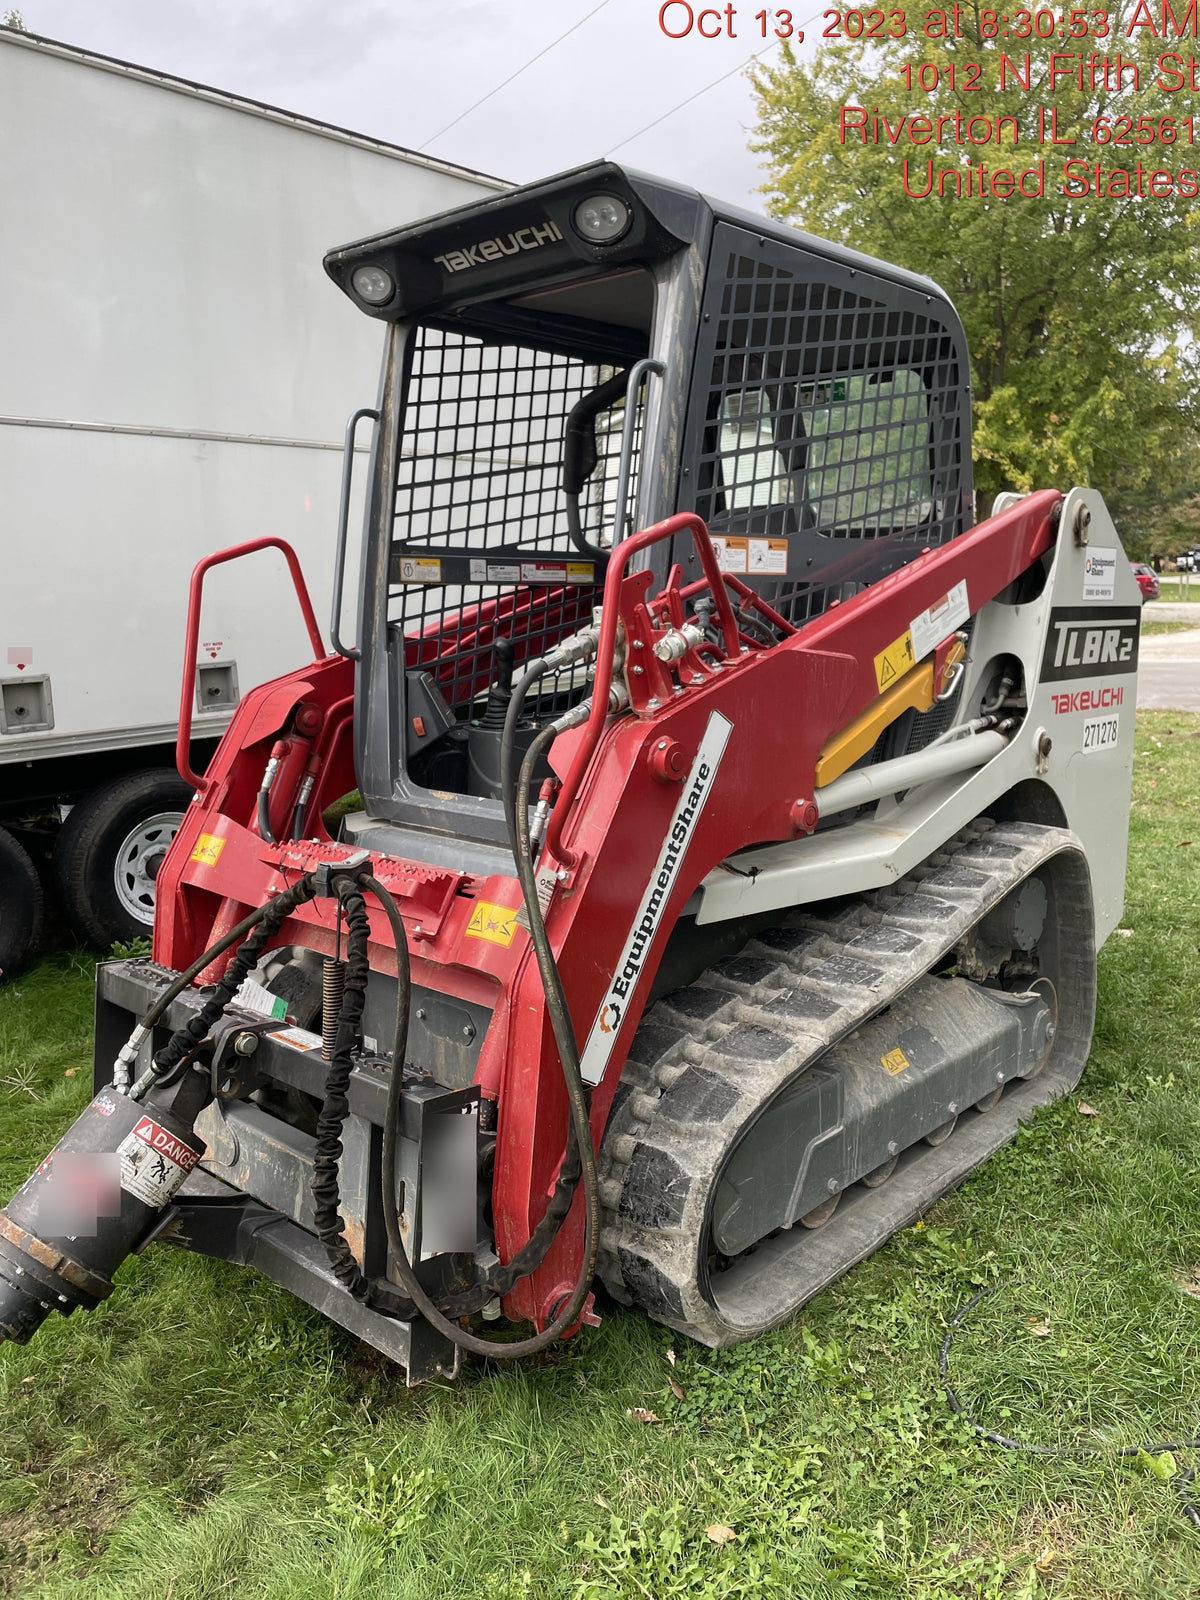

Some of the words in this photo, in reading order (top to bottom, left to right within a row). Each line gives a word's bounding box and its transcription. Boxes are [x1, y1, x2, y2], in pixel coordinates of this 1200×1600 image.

[434, 221, 563, 272] TAKEUCHI
[1051, 687, 1124, 715] TAKEUCHI
[1084, 720, 1118, 748] 271278
[152, 1131, 196, 1170] DANGE
